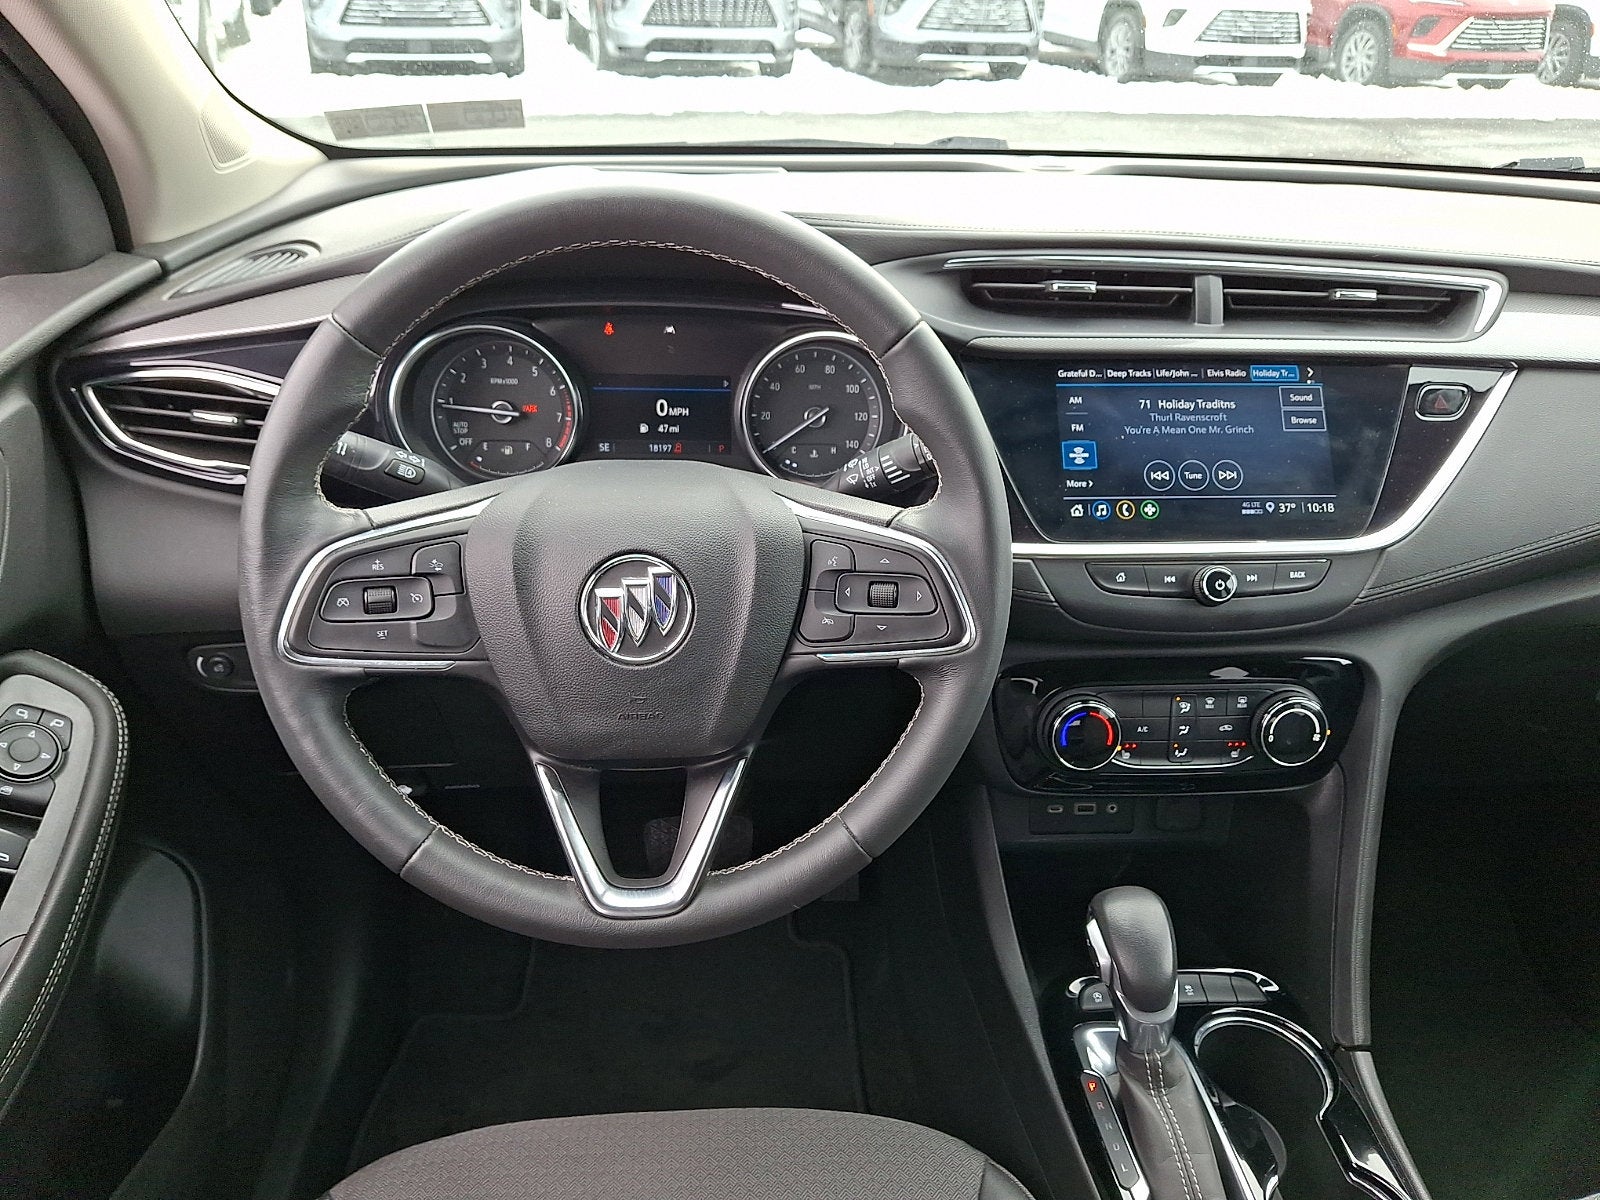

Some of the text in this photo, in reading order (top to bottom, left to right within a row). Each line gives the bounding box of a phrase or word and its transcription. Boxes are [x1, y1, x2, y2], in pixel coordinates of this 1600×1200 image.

[481, 358, 487, 369] 3
[507, 356, 514, 366] 4
[532, 366, 538, 377] 5
[795, 364, 806, 374] 60
[825, 364, 836, 375] 80
[1057, 369, 1088, 378] Grateful
[1156, 369, 1190, 379] Life/John
[1207, 369, 1247, 378] Elvis Radio
[1252, 369, 1280, 379] Holiday
[461, 373, 467, 383] 2
[1107, 369, 1152, 380] Deep Tracks
[549, 386, 556, 397] 6
[770, 382, 781, 391] 40
[845, 384, 860, 394] 100
[1068, 396, 1083, 405] AM
[1289, 393, 1313, 402] Sound
[656, 399, 690, 417] 0 MPH
[1139, 399, 1236, 411] 71 Holiday Traditns
[556, 412, 563, 423] 7
[761, 411, 771, 420] 20
[854, 412, 868, 421] 120
[1149, 412, 1228, 422] Thurl Ravenscroft
[1290, 416, 1317, 425] Browse
[1071, 423, 1085, 432] FM
[1124, 425, 1255, 435] You're A Mean One Mr. Grinch
[459, 437, 473, 445] OFF
[545, 438, 552, 448] 8
[845, 440, 860, 449] 140
[599, 442, 610, 452] SE
[649, 444, 672, 452] 18197
[1184, 471, 1203, 480] Tune
[1066, 480, 1088, 488] More
[1306, 502, 1335, 513] 10:18
[371, 563, 385, 571] RES
[1289, 571, 1306, 579] BACK
[376, 629, 389, 638] SET
[1087, 1082, 1096, 1092] P
[1096, 1101, 1105, 1111] R
[1120, 1163, 1128, 1172] L
